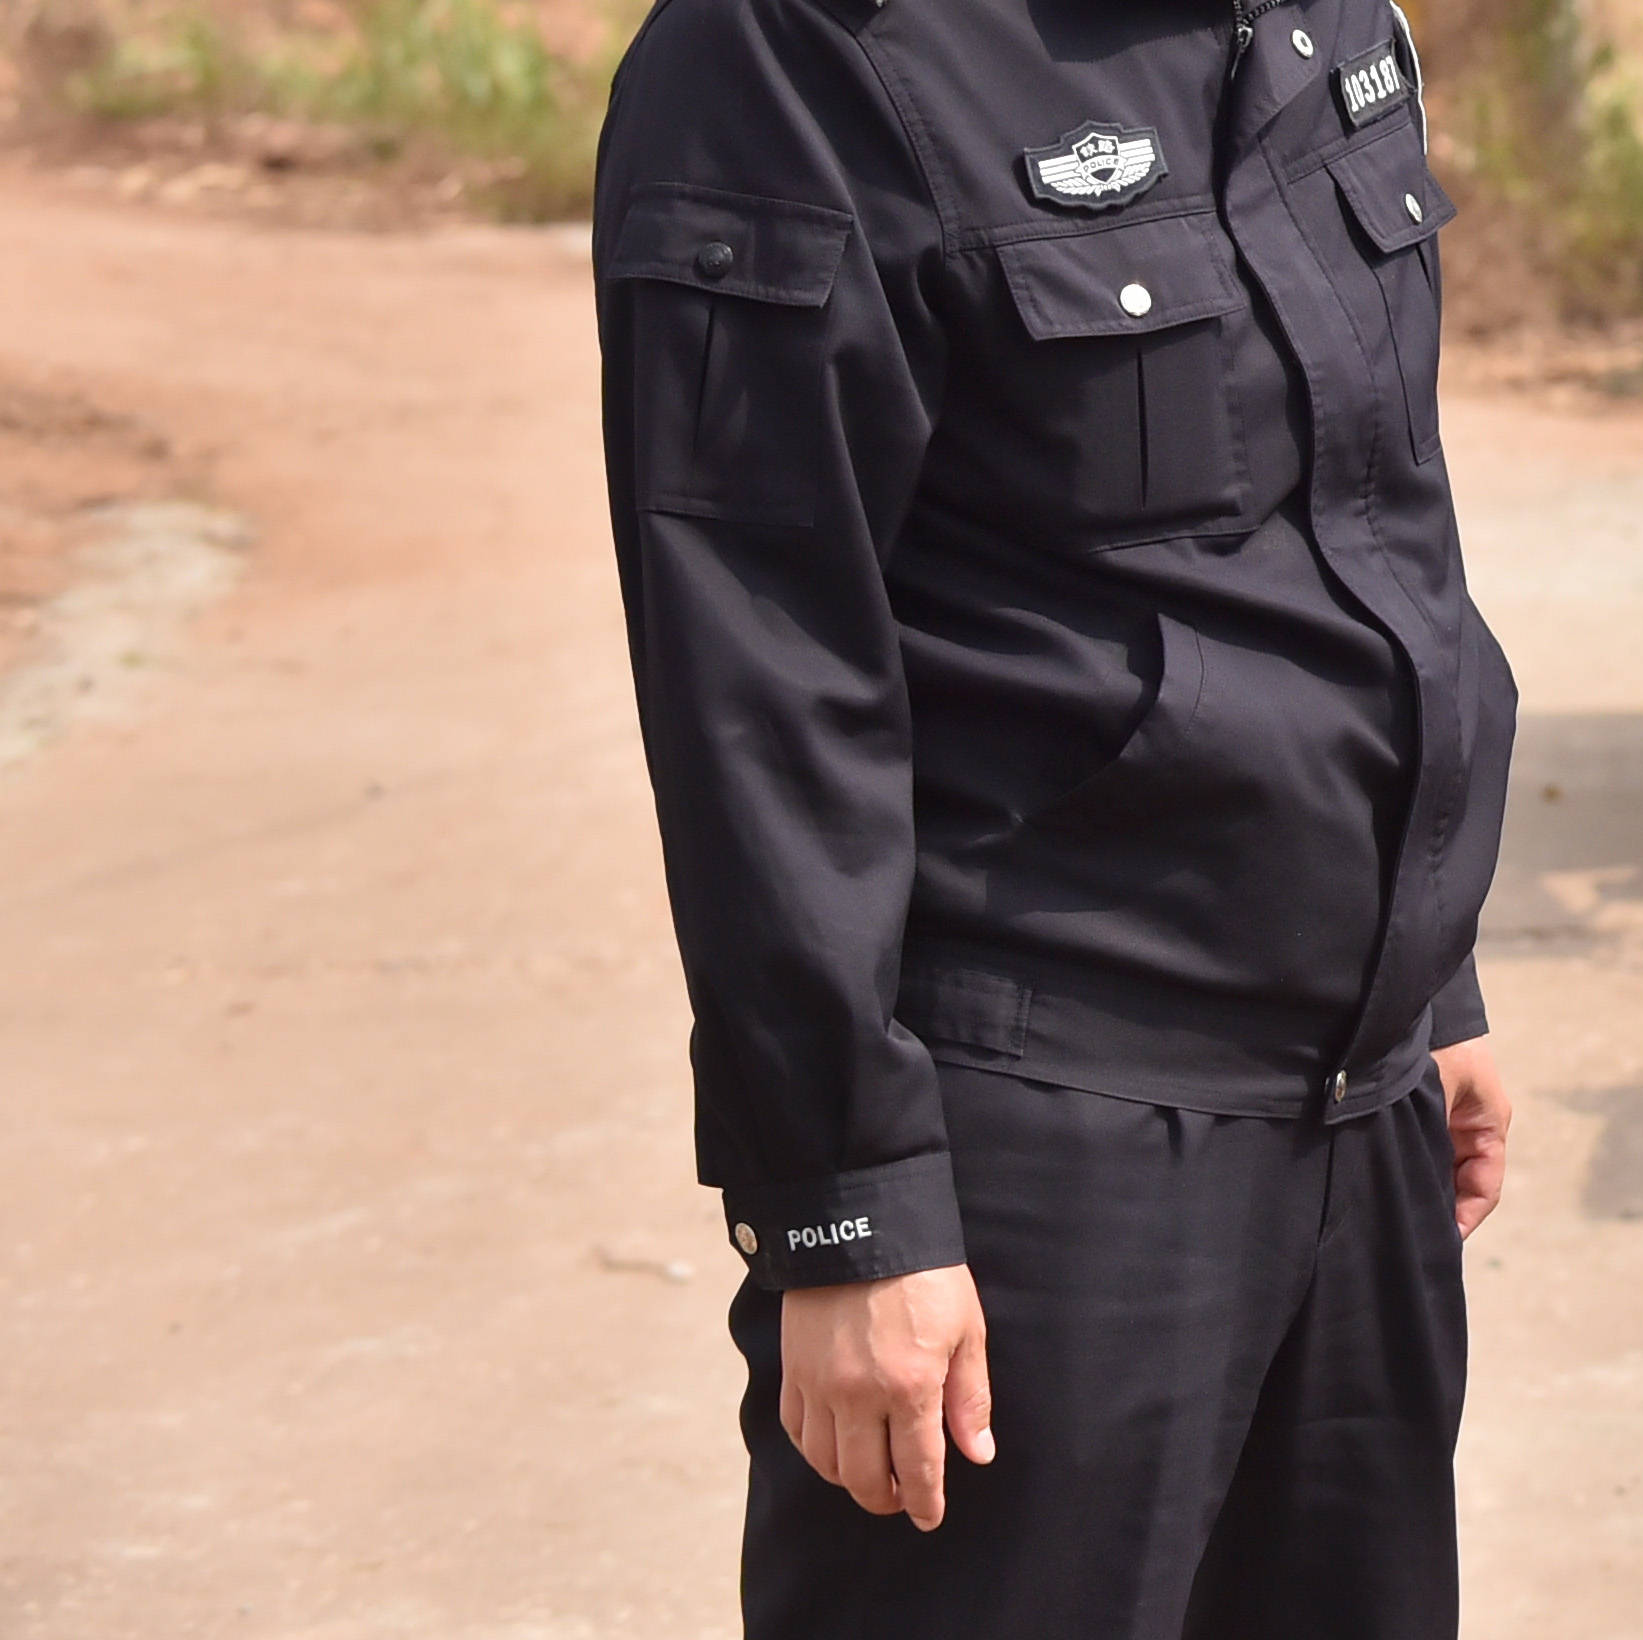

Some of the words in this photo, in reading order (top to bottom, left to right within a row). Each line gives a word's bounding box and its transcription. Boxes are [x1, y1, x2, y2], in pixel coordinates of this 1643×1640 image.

[1344, 54, 1401, 113] 103187
[1083, 158, 1120, 172] POLICE
[787, 1217, 872, 1252] POLICE
